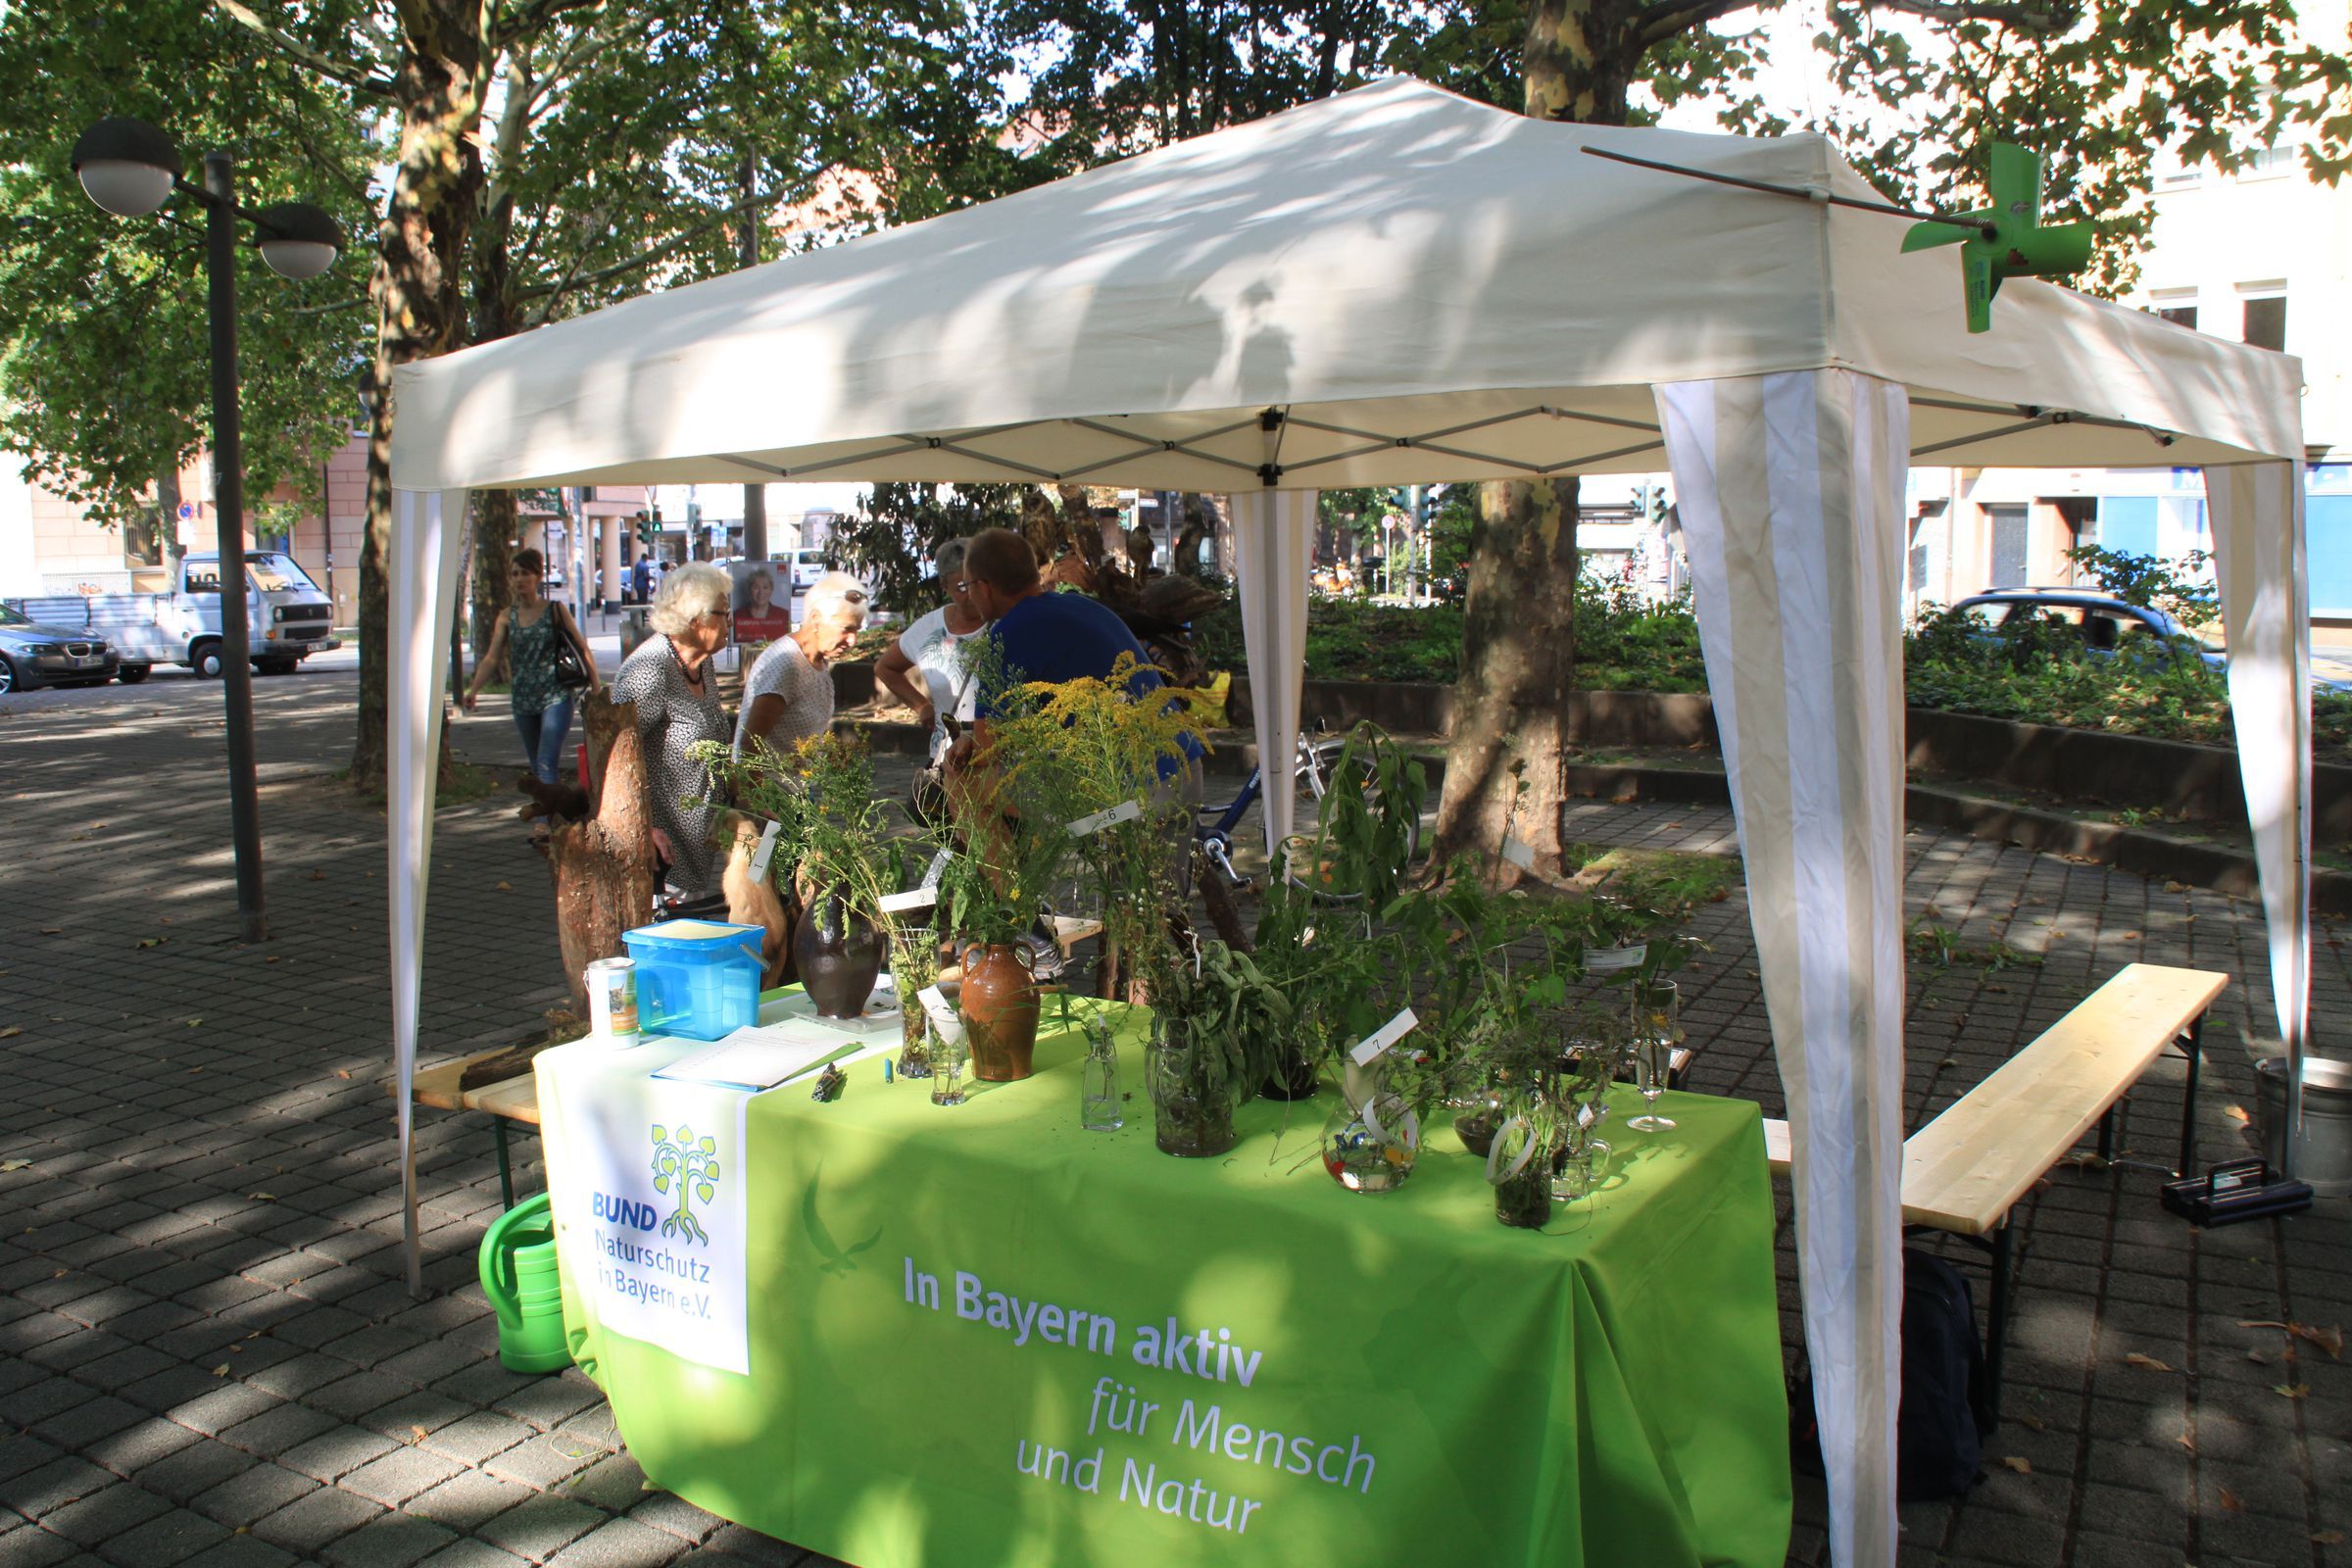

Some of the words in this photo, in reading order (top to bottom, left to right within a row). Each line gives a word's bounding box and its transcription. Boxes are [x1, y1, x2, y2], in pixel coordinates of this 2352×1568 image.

[1107, 808, 1117, 821] 6
[1372, 1038, 1381, 1051] 7
[593, 1191, 657, 1232] BUND
[595, 1228, 710, 1284] Naturschutz
[598, 1260, 612, 1288] in
[614, 1268, 675, 1309] Bayern
[680, 1293, 711, 1320] e.V.
[905, 1255, 939, 1310] In
[956, 1270, 1116, 1356] Bayern
[1132, 1316, 1263, 1388] aktiv
[1087, 1376, 1160, 1436] für
[1172, 1398, 1376, 1494] Mensch
[1016, 1439, 1104, 1494] und
[1119, 1457, 1262, 1534] Natur
